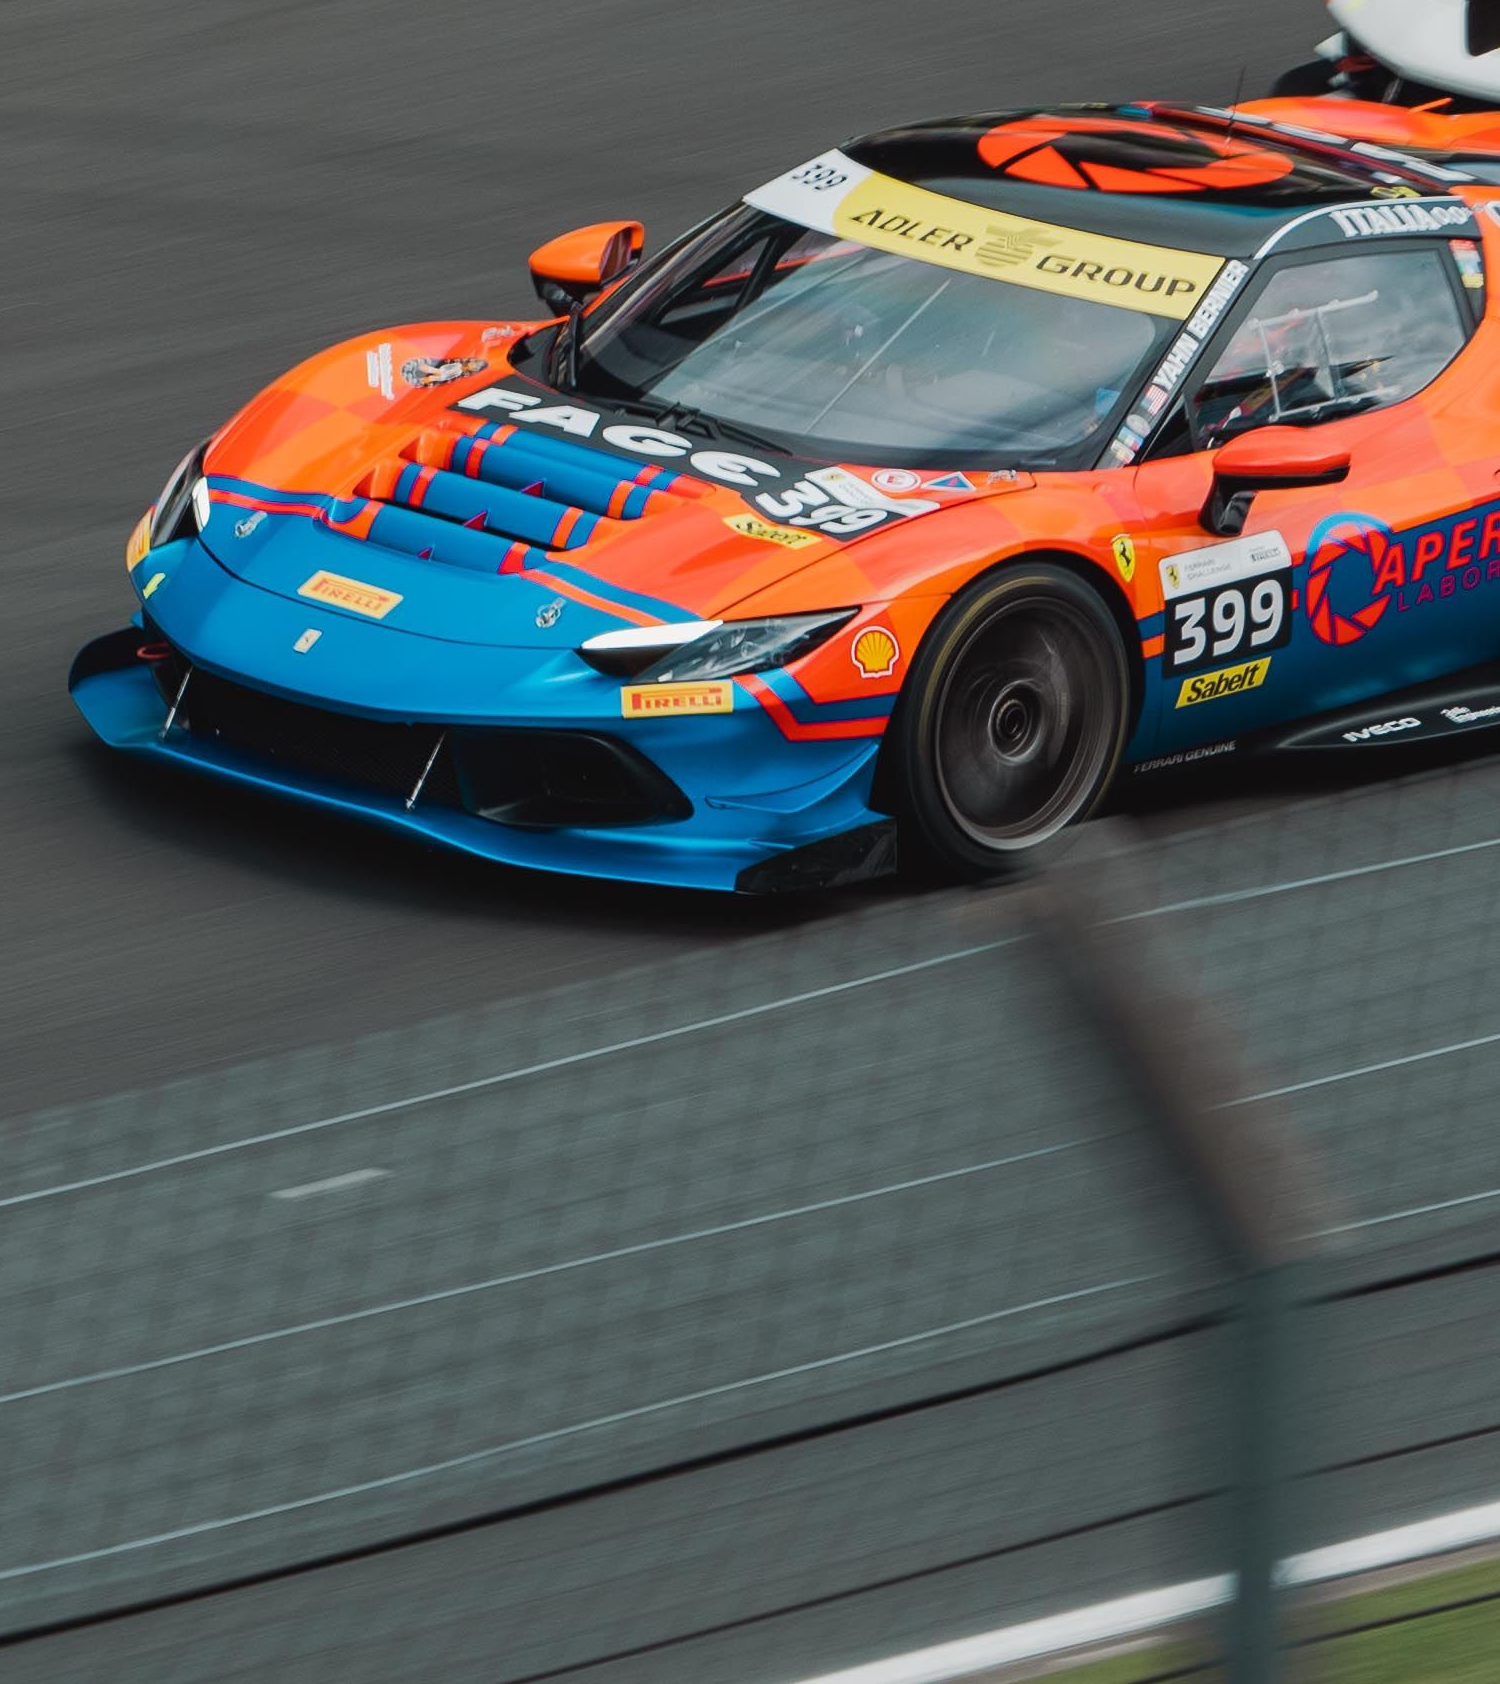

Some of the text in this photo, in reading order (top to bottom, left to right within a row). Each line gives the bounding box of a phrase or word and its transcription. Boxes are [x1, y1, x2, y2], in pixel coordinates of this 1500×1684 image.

[792, 163, 847, 193] 399
[850, 208, 1197, 298] ADLER GROUP
[756, 480, 888, 534] 399
[316, 578, 390, 611] PIRELLI
[1173, 579, 1284, 666] 399
[631, 687, 723, 712] PIRELLI
[1186, 664, 1260, 703] Sabelt
[1342, 717, 1422, 742] IVECO
